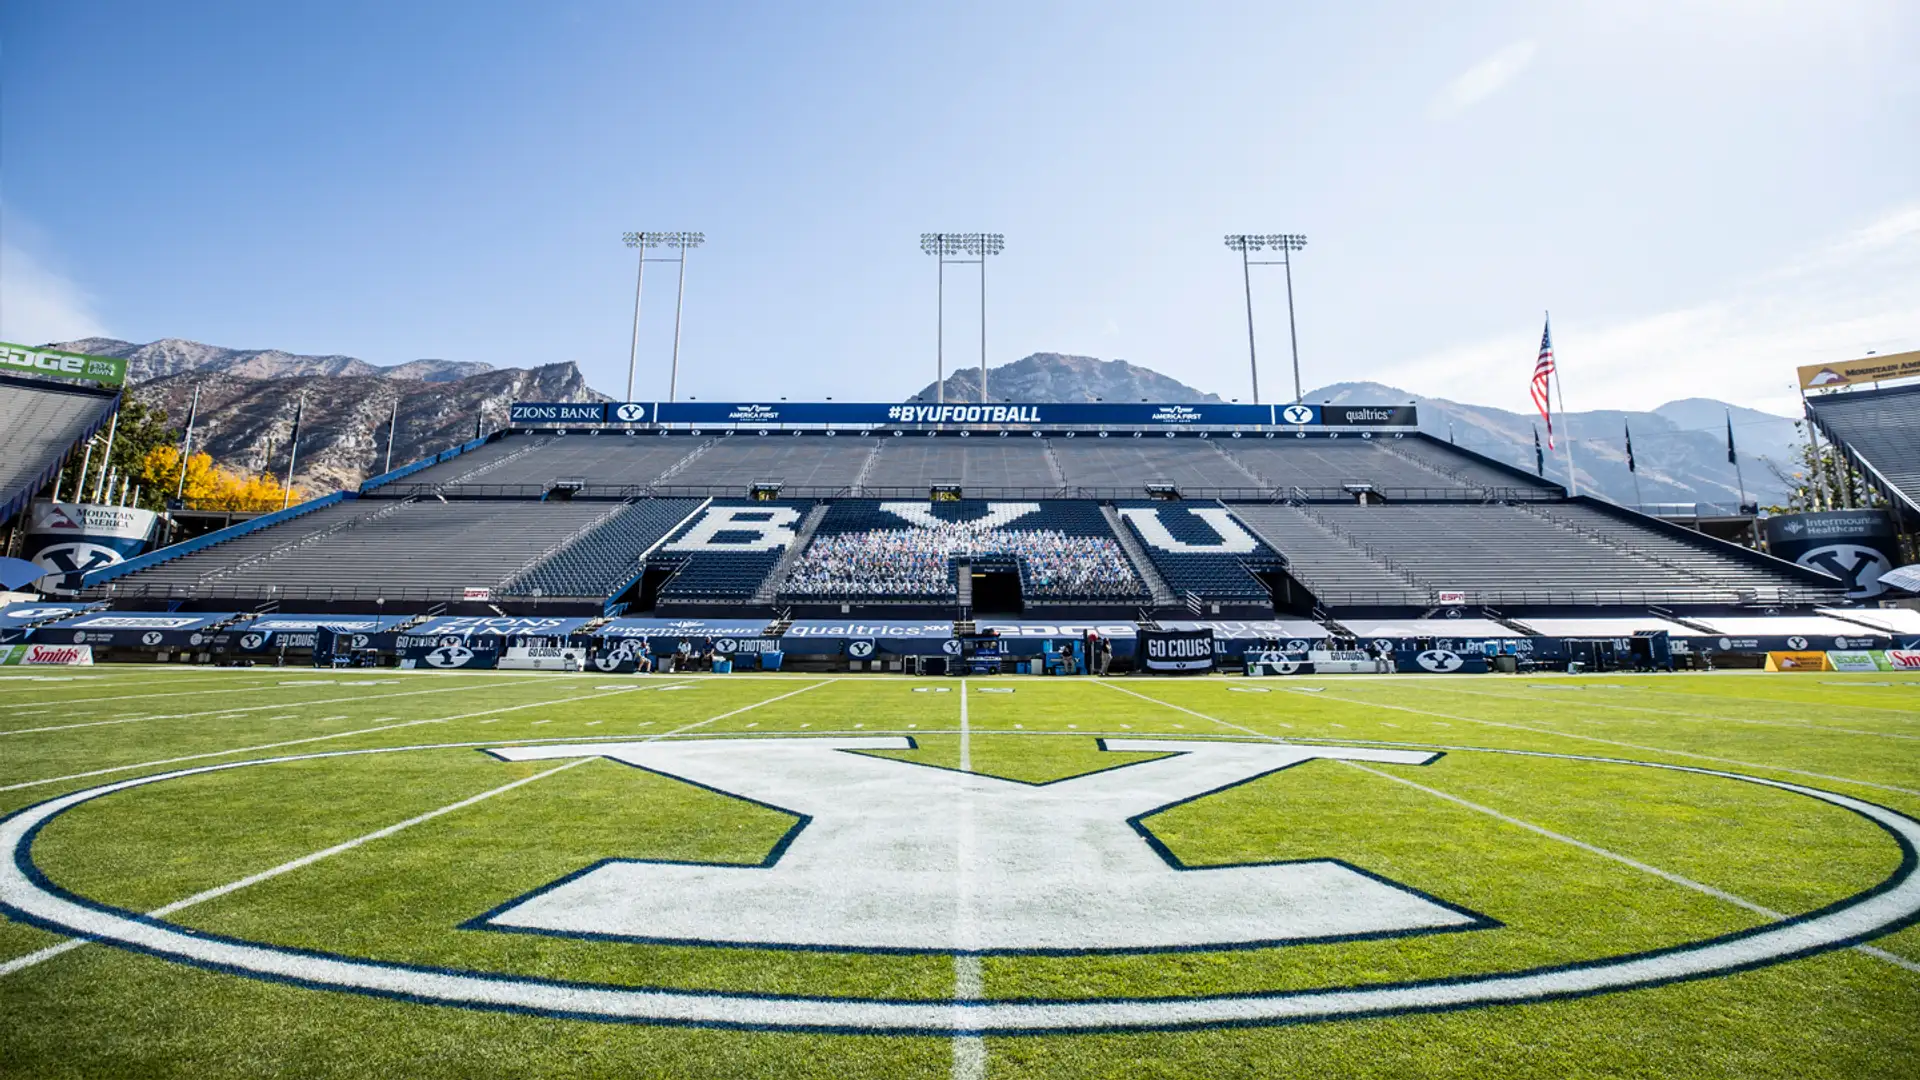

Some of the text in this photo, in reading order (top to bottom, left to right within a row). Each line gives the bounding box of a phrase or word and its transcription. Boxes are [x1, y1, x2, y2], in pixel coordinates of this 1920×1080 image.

[513, 407, 600, 418] ZIONS BANK
[888, 406, 1041, 422] #BYUFOOTBALL
[1346, 408, 1389, 423] qualtrics
[76, 509, 134, 520] MOUNTAIN
[80, 517, 129, 528] AMERICA
[1806, 517, 1882, 526] Intermountain
[1807, 526, 1864, 535] Healthcare
[443, 617, 566, 627] ZIONS
[604, 625, 752, 634] Intermountain
[289, 635, 316, 647] COUG
[739, 640, 779, 653] FOOTBALL
[528, 648, 562, 657] GO COUGS
[1148, 639, 1166, 657] GO
[1168, 638, 1211, 657] COUGS
[28, 646, 79, 662] Smith's
